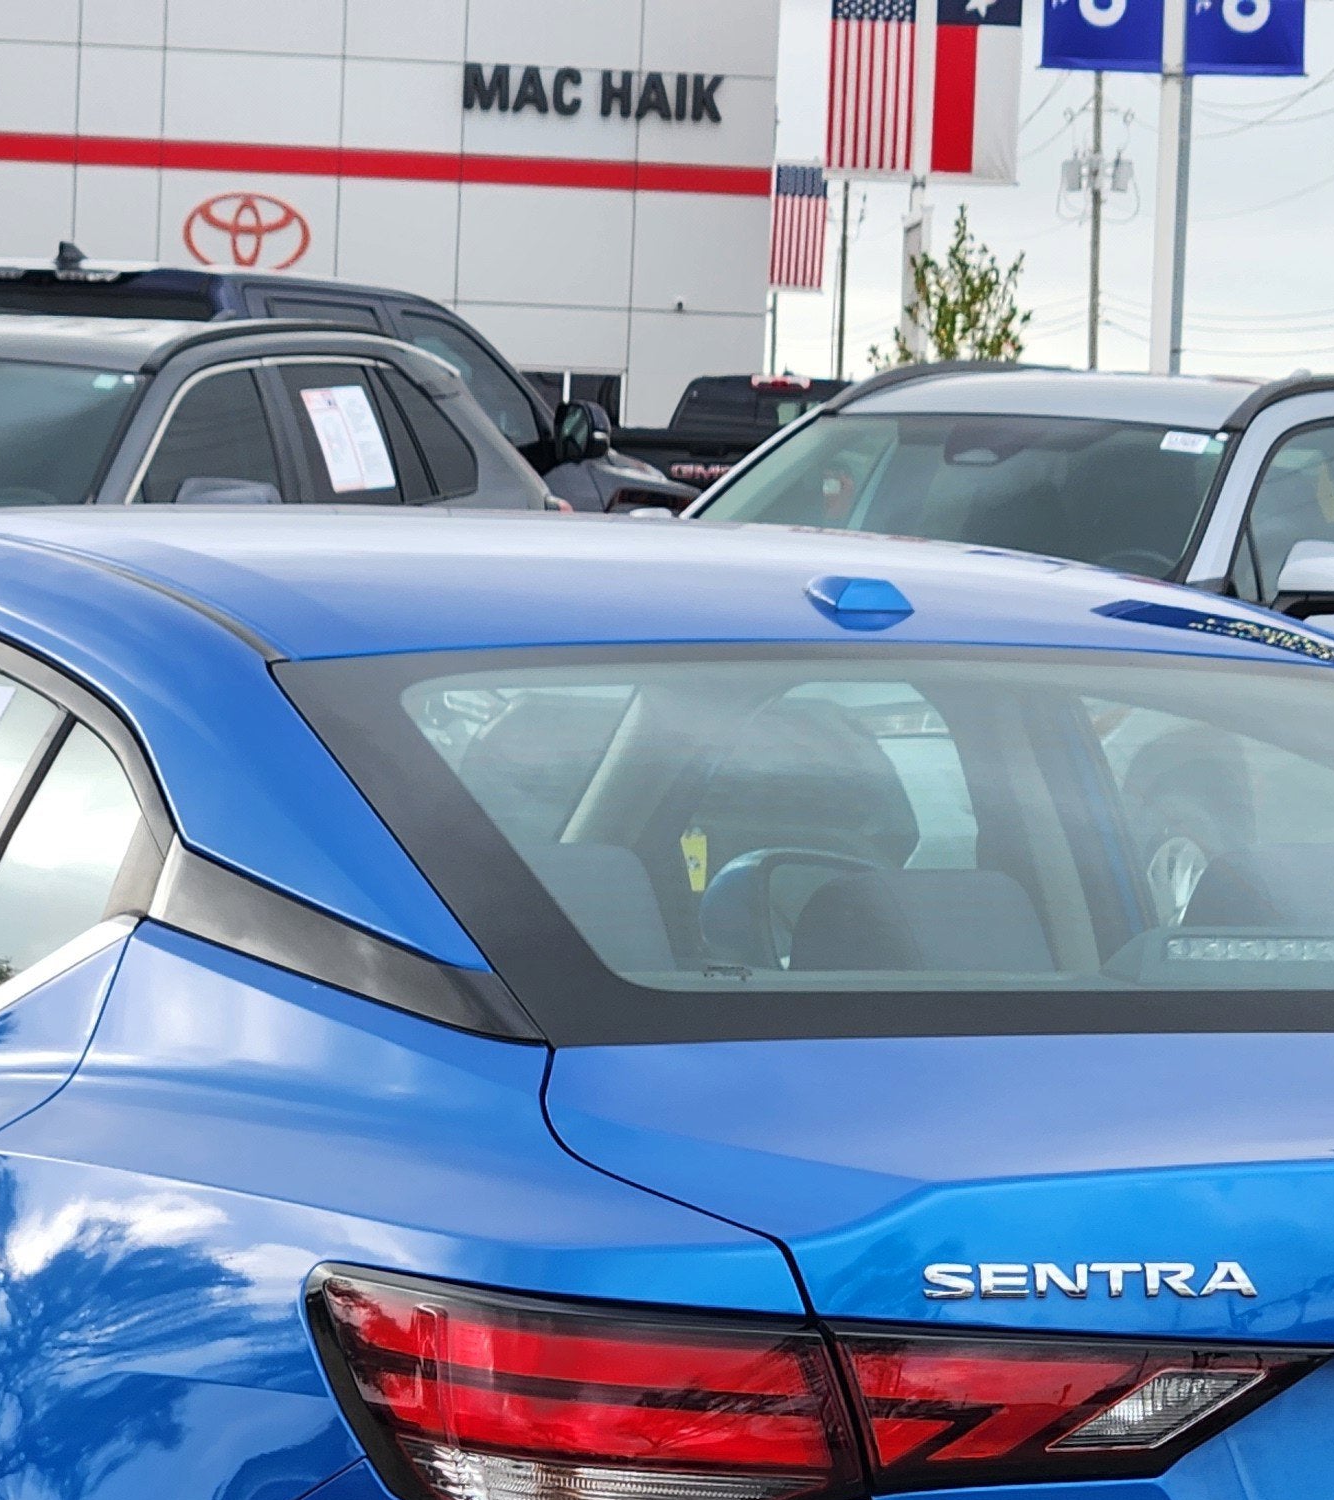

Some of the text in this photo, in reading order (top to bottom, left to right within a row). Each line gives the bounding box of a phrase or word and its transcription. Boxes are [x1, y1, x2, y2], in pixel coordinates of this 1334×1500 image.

[463, 62, 724, 124] MAC HAIK
[923, 1261, 1259, 1299] SENTRA
